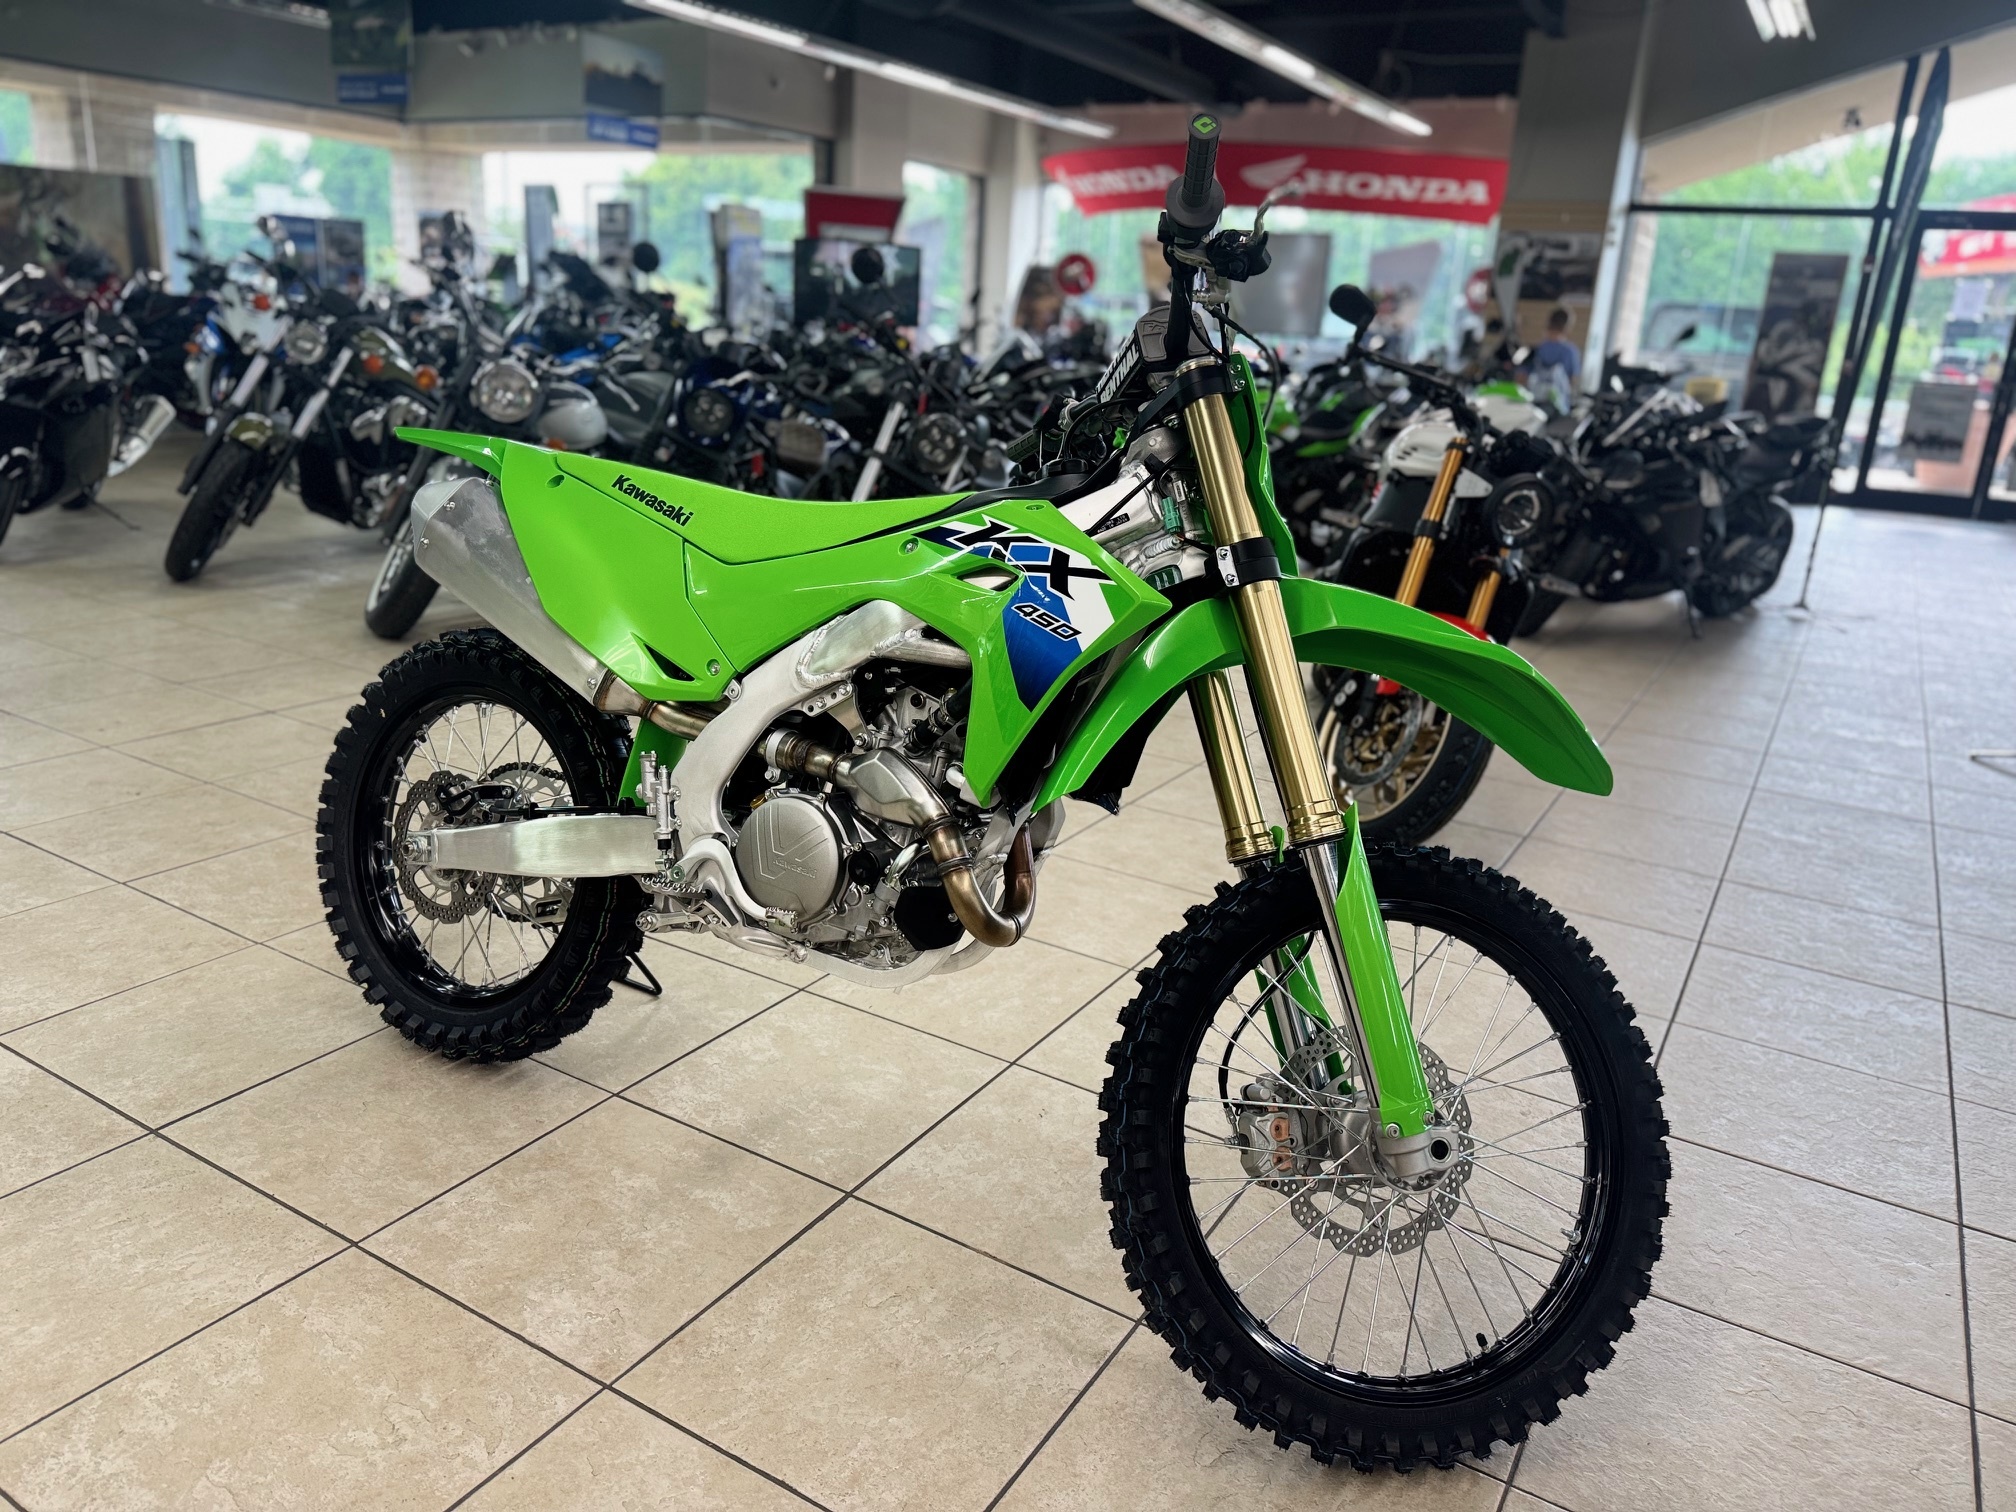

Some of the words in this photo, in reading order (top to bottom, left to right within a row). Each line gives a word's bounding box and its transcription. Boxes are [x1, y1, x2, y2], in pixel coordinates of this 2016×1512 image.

[1301, 167, 1491, 205] HONDA
[1100, 343, 1140, 403] RENTHAL
[611, 474, 694, 526] Kawasaki
[1011, 602, 1082, 641] 450
